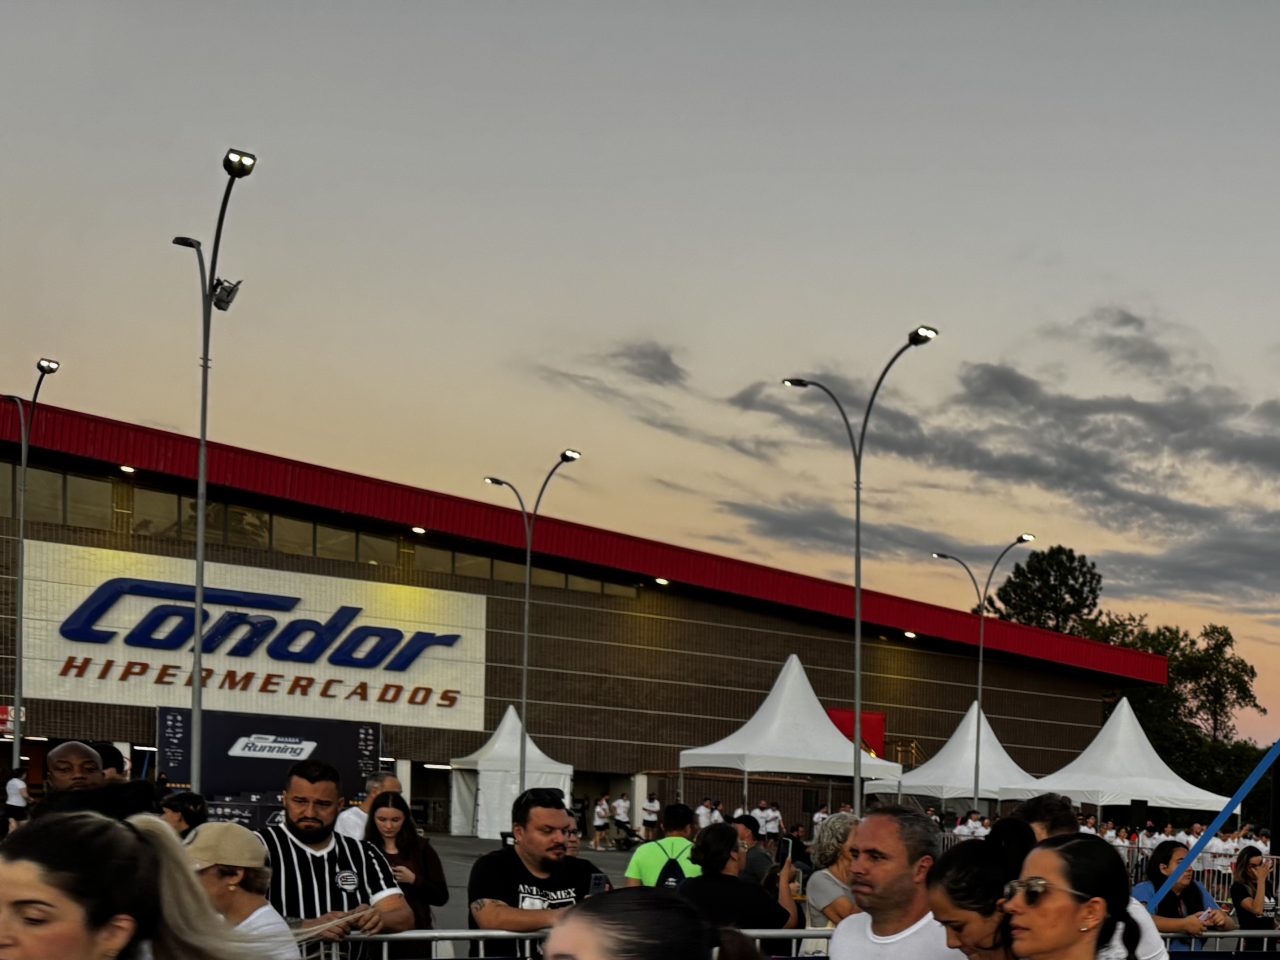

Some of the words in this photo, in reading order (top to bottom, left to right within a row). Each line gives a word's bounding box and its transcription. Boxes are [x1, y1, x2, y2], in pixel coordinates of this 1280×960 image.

[59, 577, 461, 672] Condor
[59, 656, 461, 708] HIPERMERCADOS
[241, 742, 304, 757] Running
